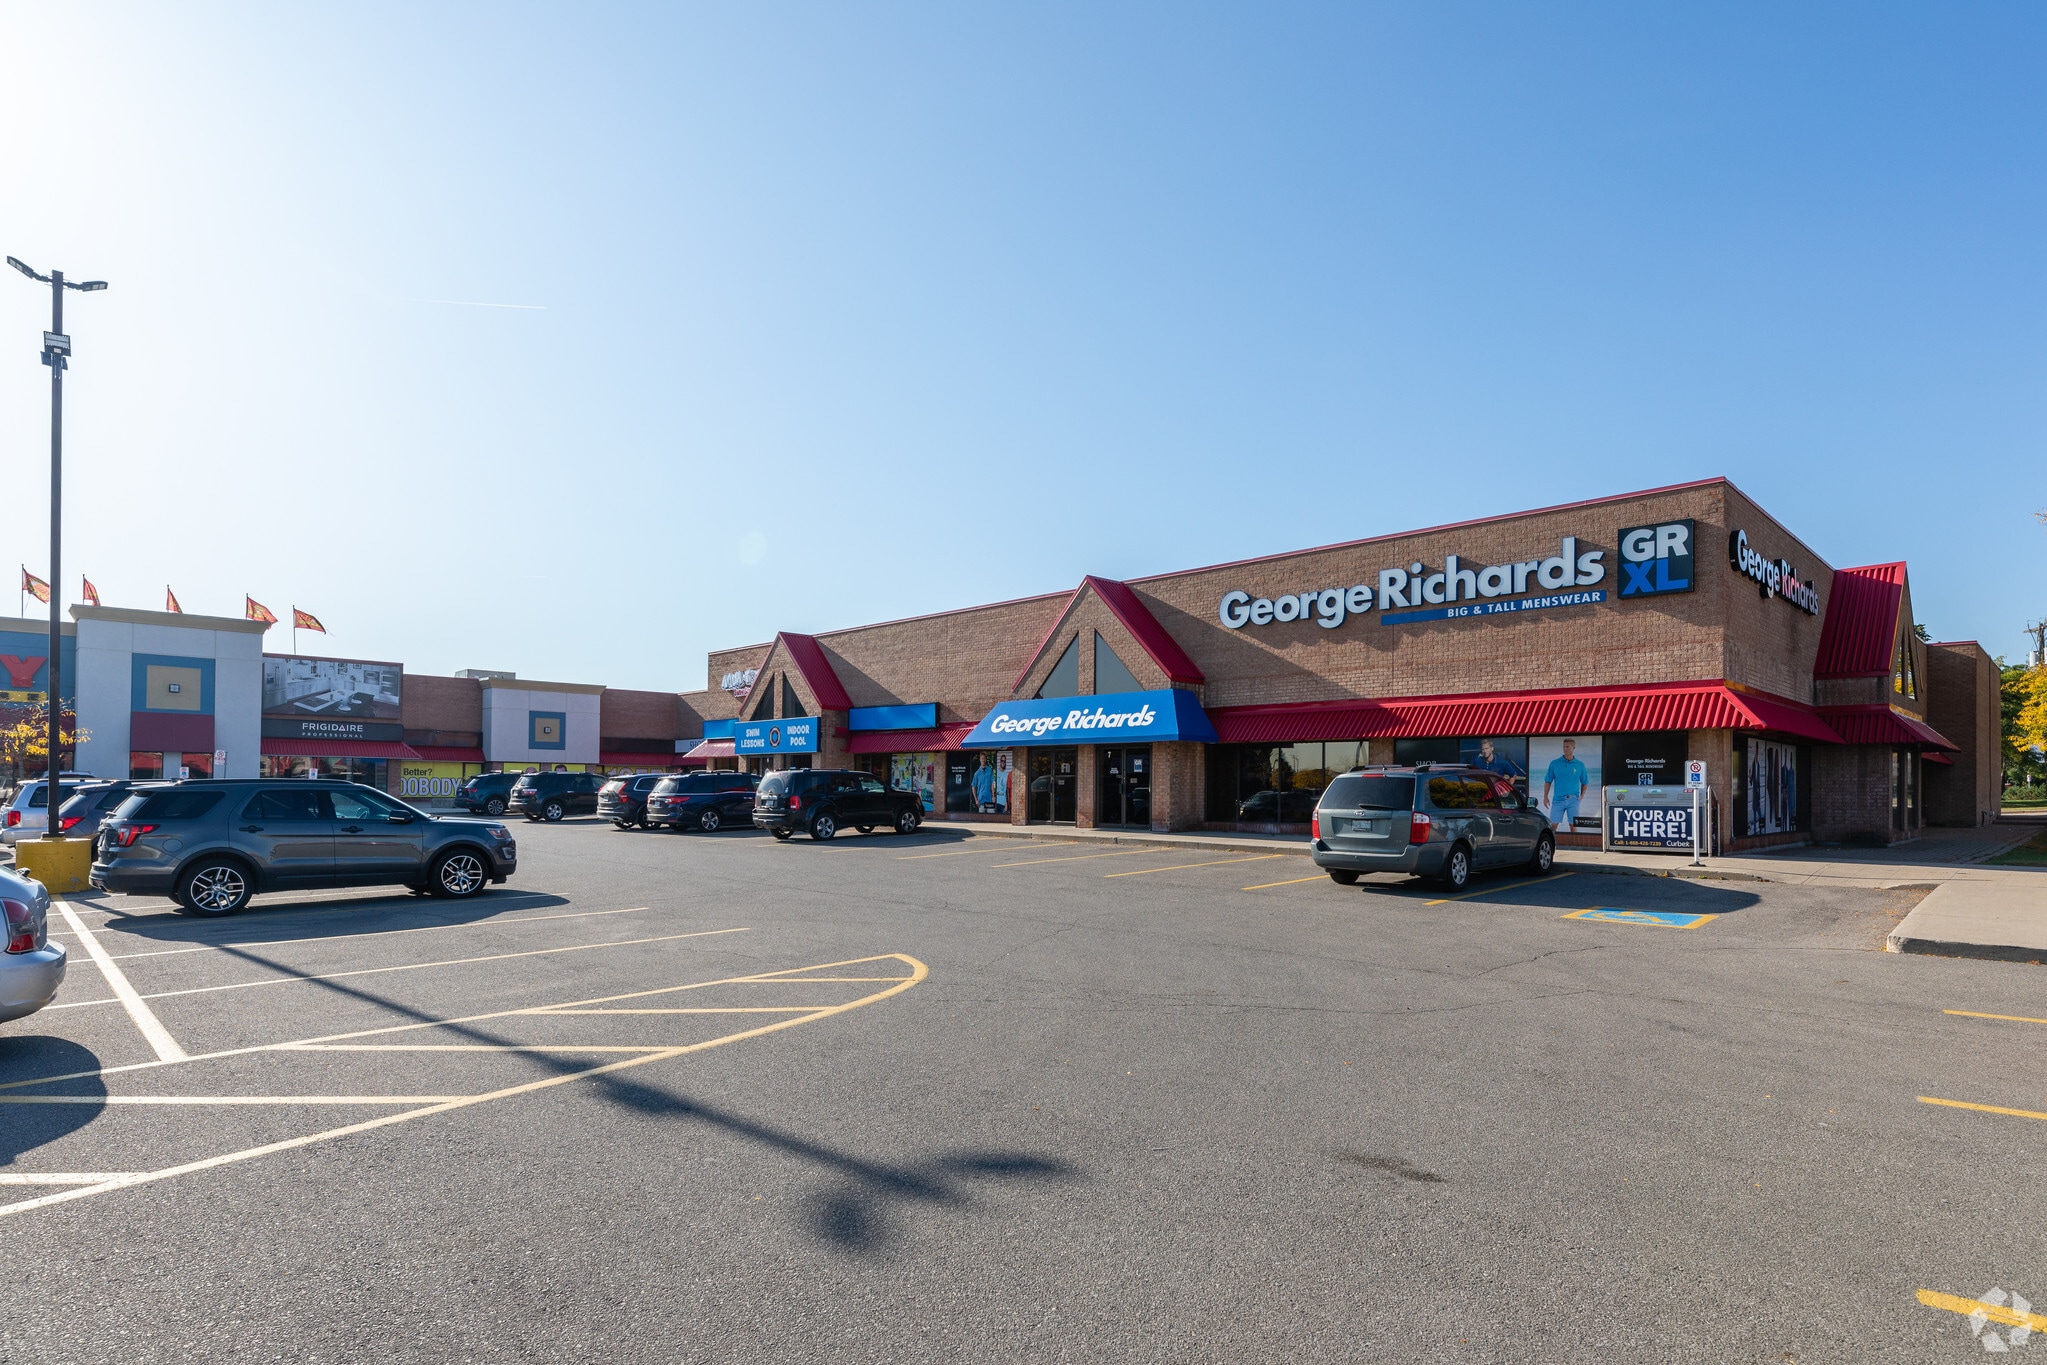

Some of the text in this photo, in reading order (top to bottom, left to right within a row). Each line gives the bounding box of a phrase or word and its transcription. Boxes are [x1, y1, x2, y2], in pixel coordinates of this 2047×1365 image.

[1622, 524, 1689, 562] GR
[1622, 557, 1689, 595] XL
[1736, 529, 1818, 615] George Richards
[1219, 536, 1606, 629] George Richards
[1447, 592, 1601, 618] BIG & TALL MENSWEAR
[990, 704, 1156, 736] George Richards
[302, 722, 364, 732] FRIGIDAIRE
[745, 728, 760, 738] SWIM
[787, 725, 810, 735] INDOOR
[740, 738, 765, 748] LESSONS
[790, 737, 807, 746] POOL
[403, 768, 433, 776] Better?
[1624, 809, 1686, 821] YOUR AD
[1624, 821, 1687, 838] HERE!
[1666, 840, 1690, 848] Curbex
